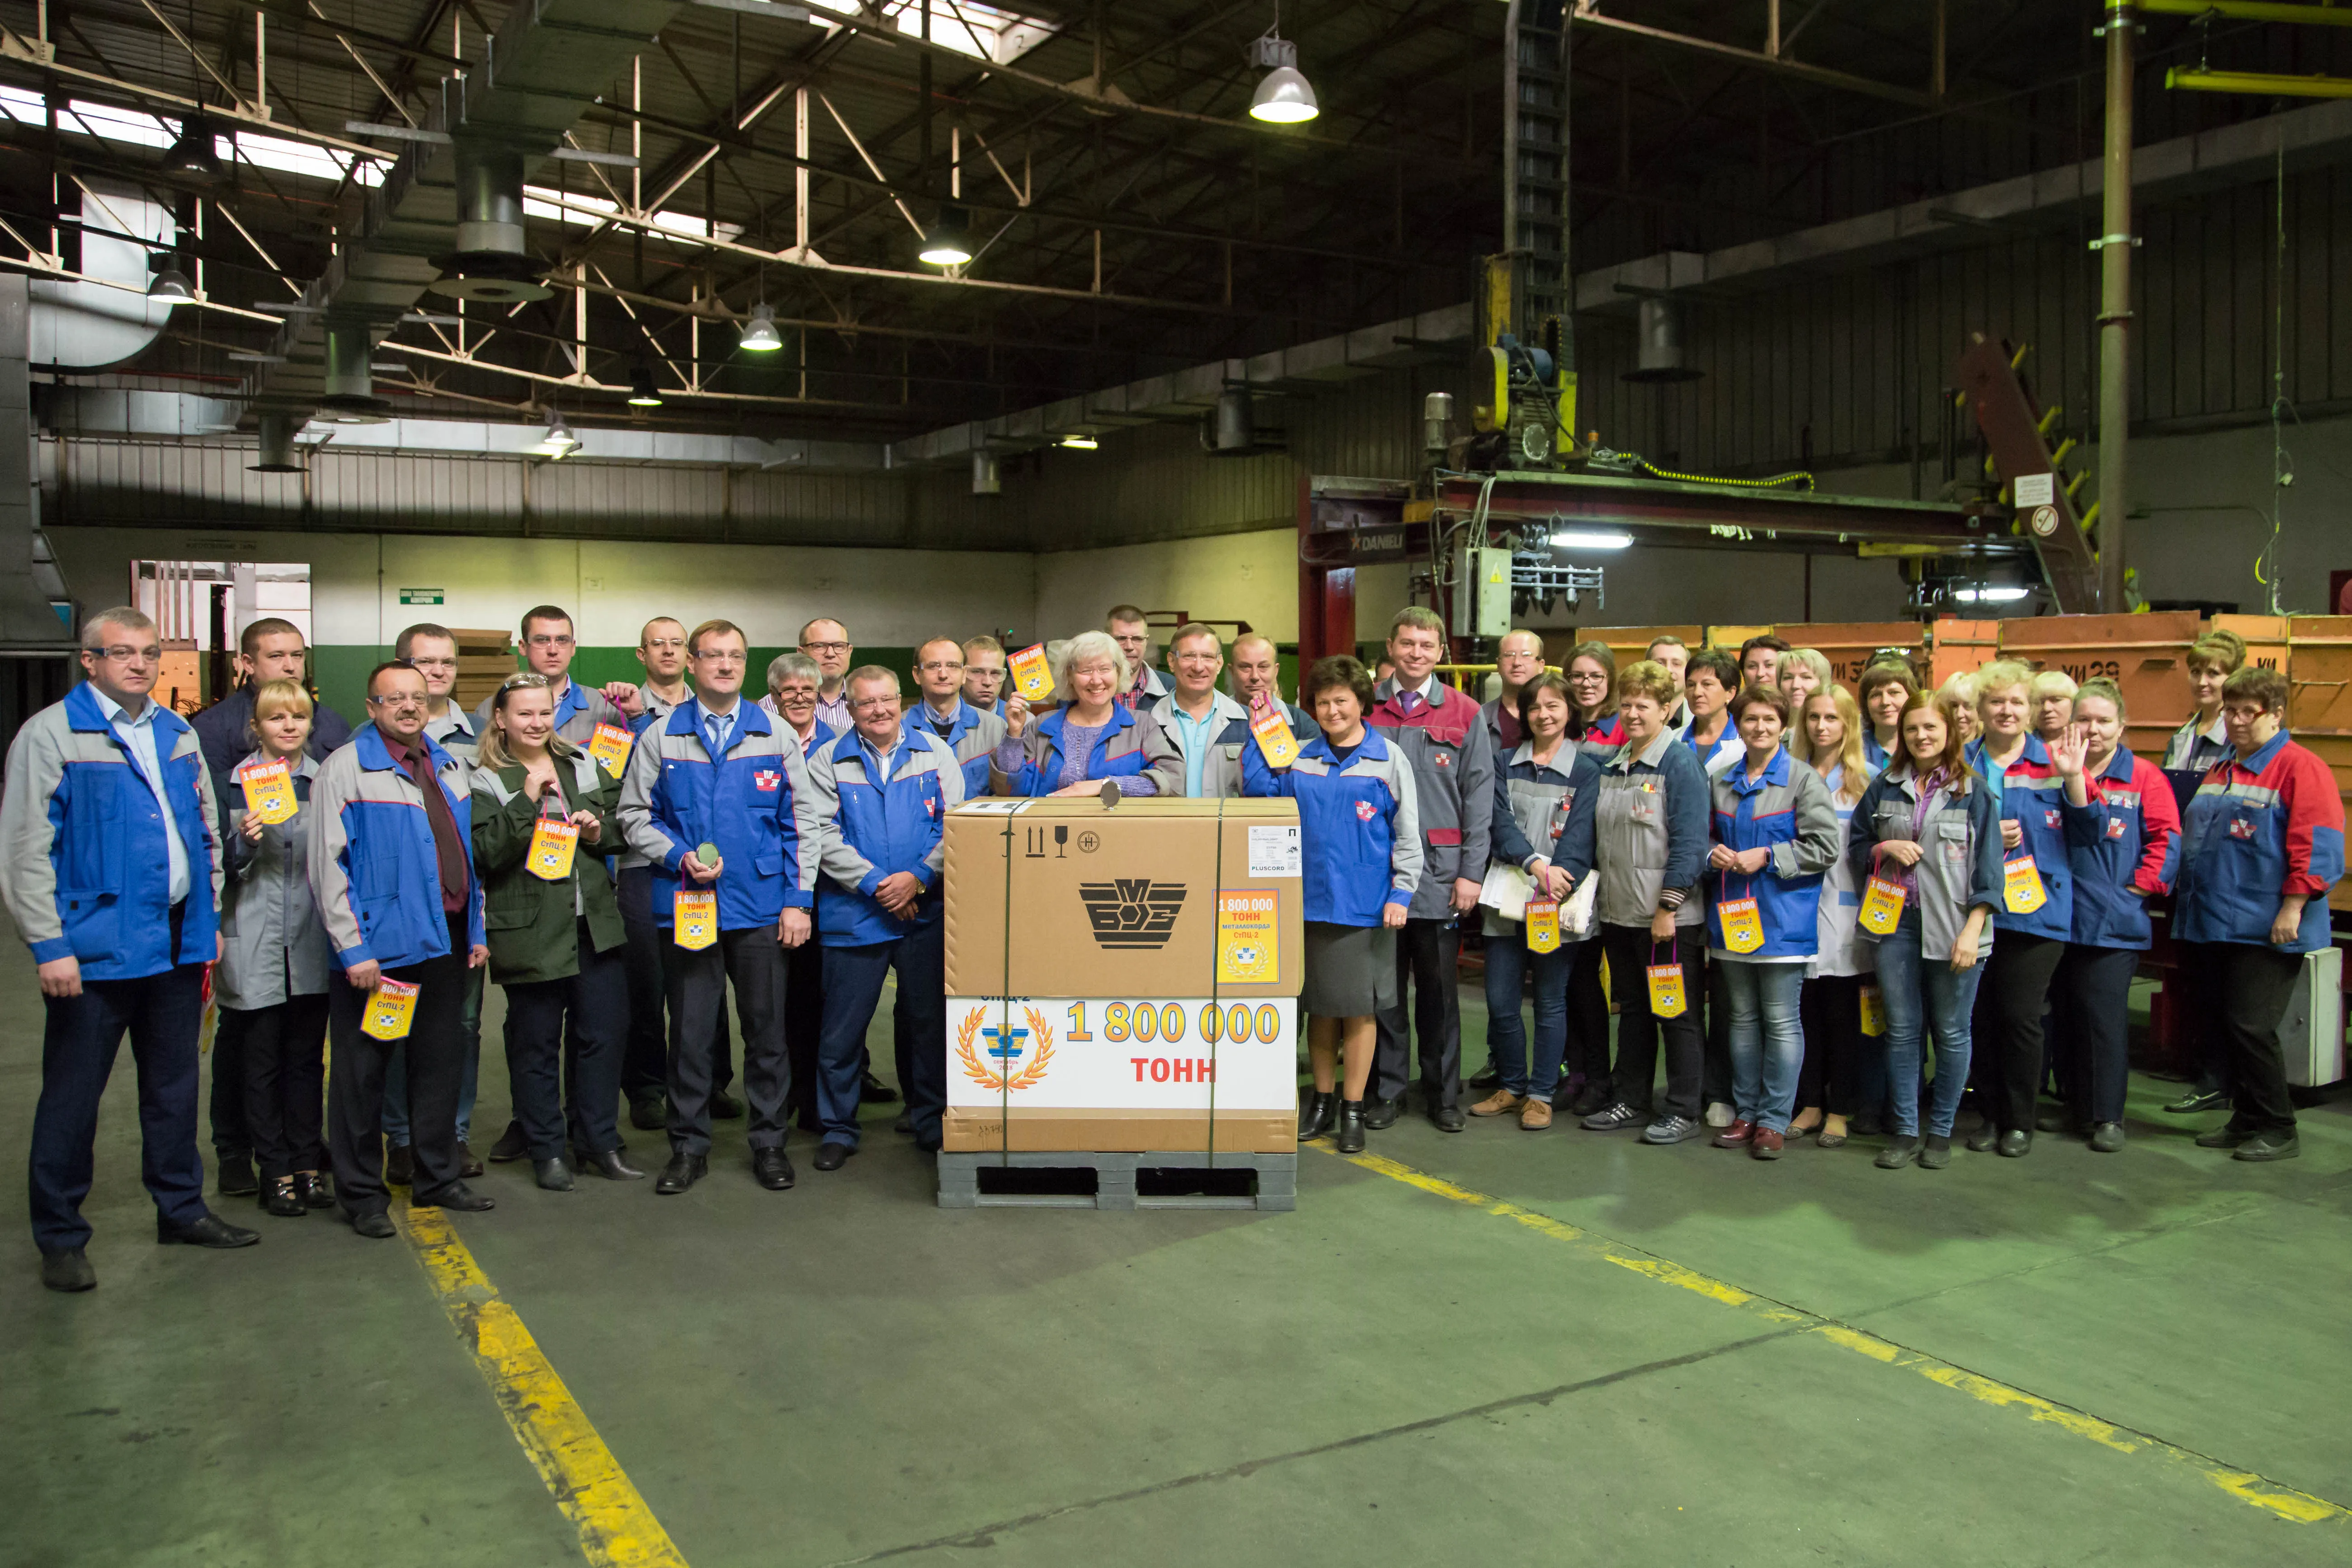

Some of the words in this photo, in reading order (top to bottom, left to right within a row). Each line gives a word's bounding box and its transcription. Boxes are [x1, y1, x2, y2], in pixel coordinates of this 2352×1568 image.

[1362, 534, 1402, 551] DANIELI
[1016, 653, 1028, 664] 800
[1029, 647, 1042, 658] 000
[1258, 721, 1271, 732] 800
[1270, 715, 1282, 726] 000
[603, 728, 617, 738] 800
[618, 733, 632, 743] 000
[1264, 725, 1279, 736] ТОНН
[604, 737, 622, 746] ТОНН
[243, 772, 250, 781] 1
[250, 768, 267, 779] 800
[269, 763, 285, 775] 000
[256, 776, 278, 785] ТОНН
[538, 822, 542, 830] 1
[545, 823, 560, 833] 800
[561, 826, 576, 836] 000
[547, 833, 566, 841] ТОНН
[2018, 859, 2032, 870] 000
[1877, 881, 1890, 892] 800
[1891, 886, 1905, 897] 000
[679, 895, 682, 904] 1
[684, 895, 698, 903] 800
[700, 895, 714, 903] 000
[1219, 899, 1225, 911] 1
[1228, 899, 1249, 911] 800
[1252, 899, 1273, 911] 000
[1726, 904, 1740, 913] 800
[1741, 901, 1755, 910] 000
[1232, 913, 1260, 921] ТОНН
[1668, 967, 1680, 975] 000
[400, 987, 416, 996] 000
[1067, 1001, 1093, 1042] 1
[1104, 1002, 1186, 1043] 800
[1199, 1003, 1280, 1044] 000
[1131, 1058, 1216, 1083] ТОНН
